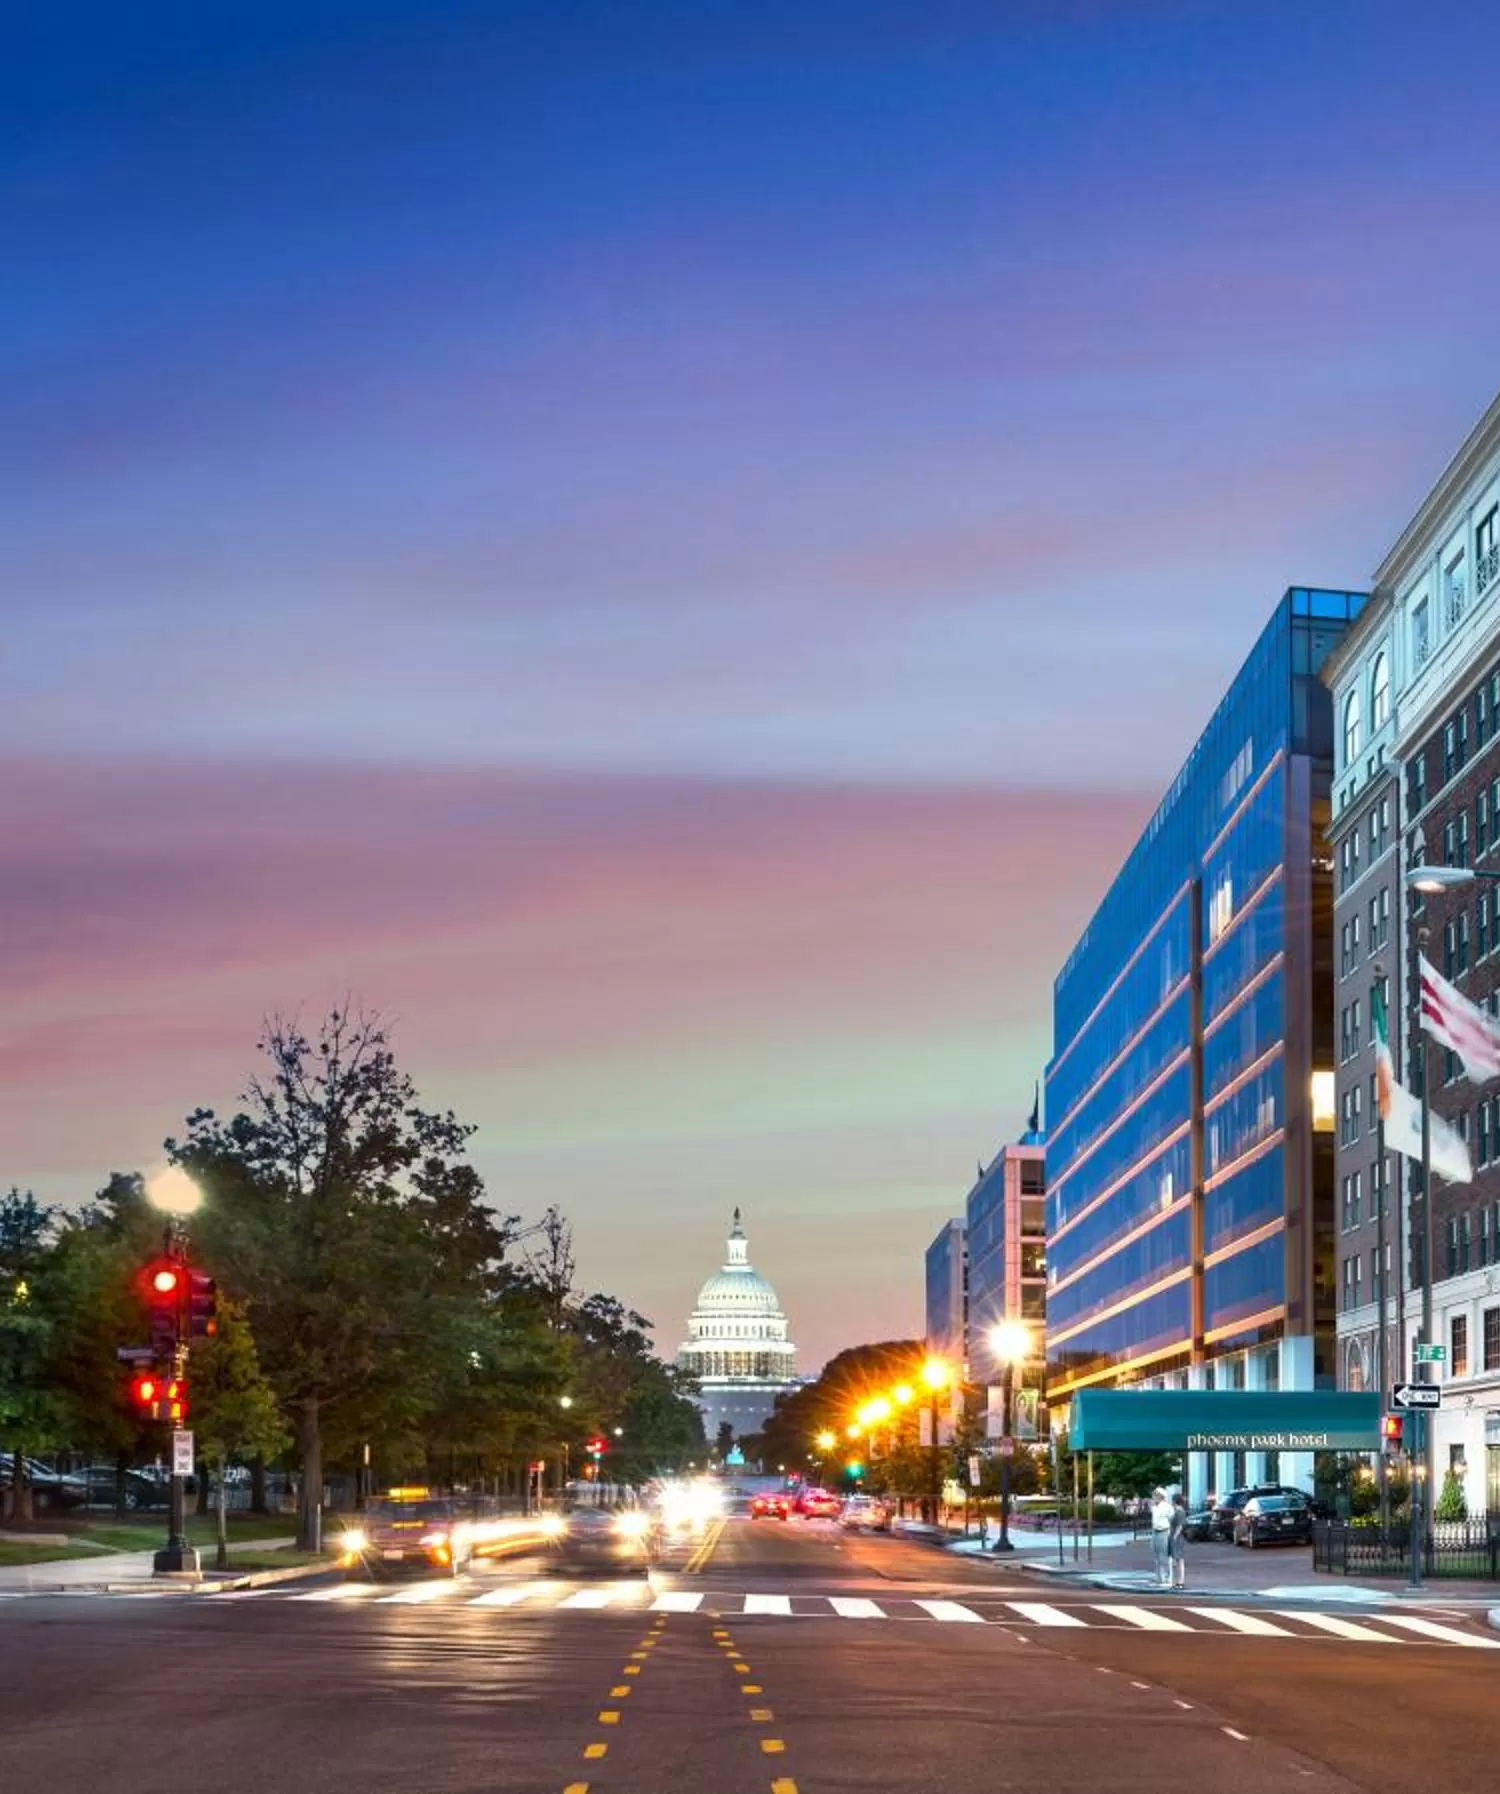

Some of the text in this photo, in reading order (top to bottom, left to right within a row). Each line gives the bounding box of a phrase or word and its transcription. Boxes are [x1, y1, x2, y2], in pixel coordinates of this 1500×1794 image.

[1187, 1433, 1328, 1448] phoenix park hotel
